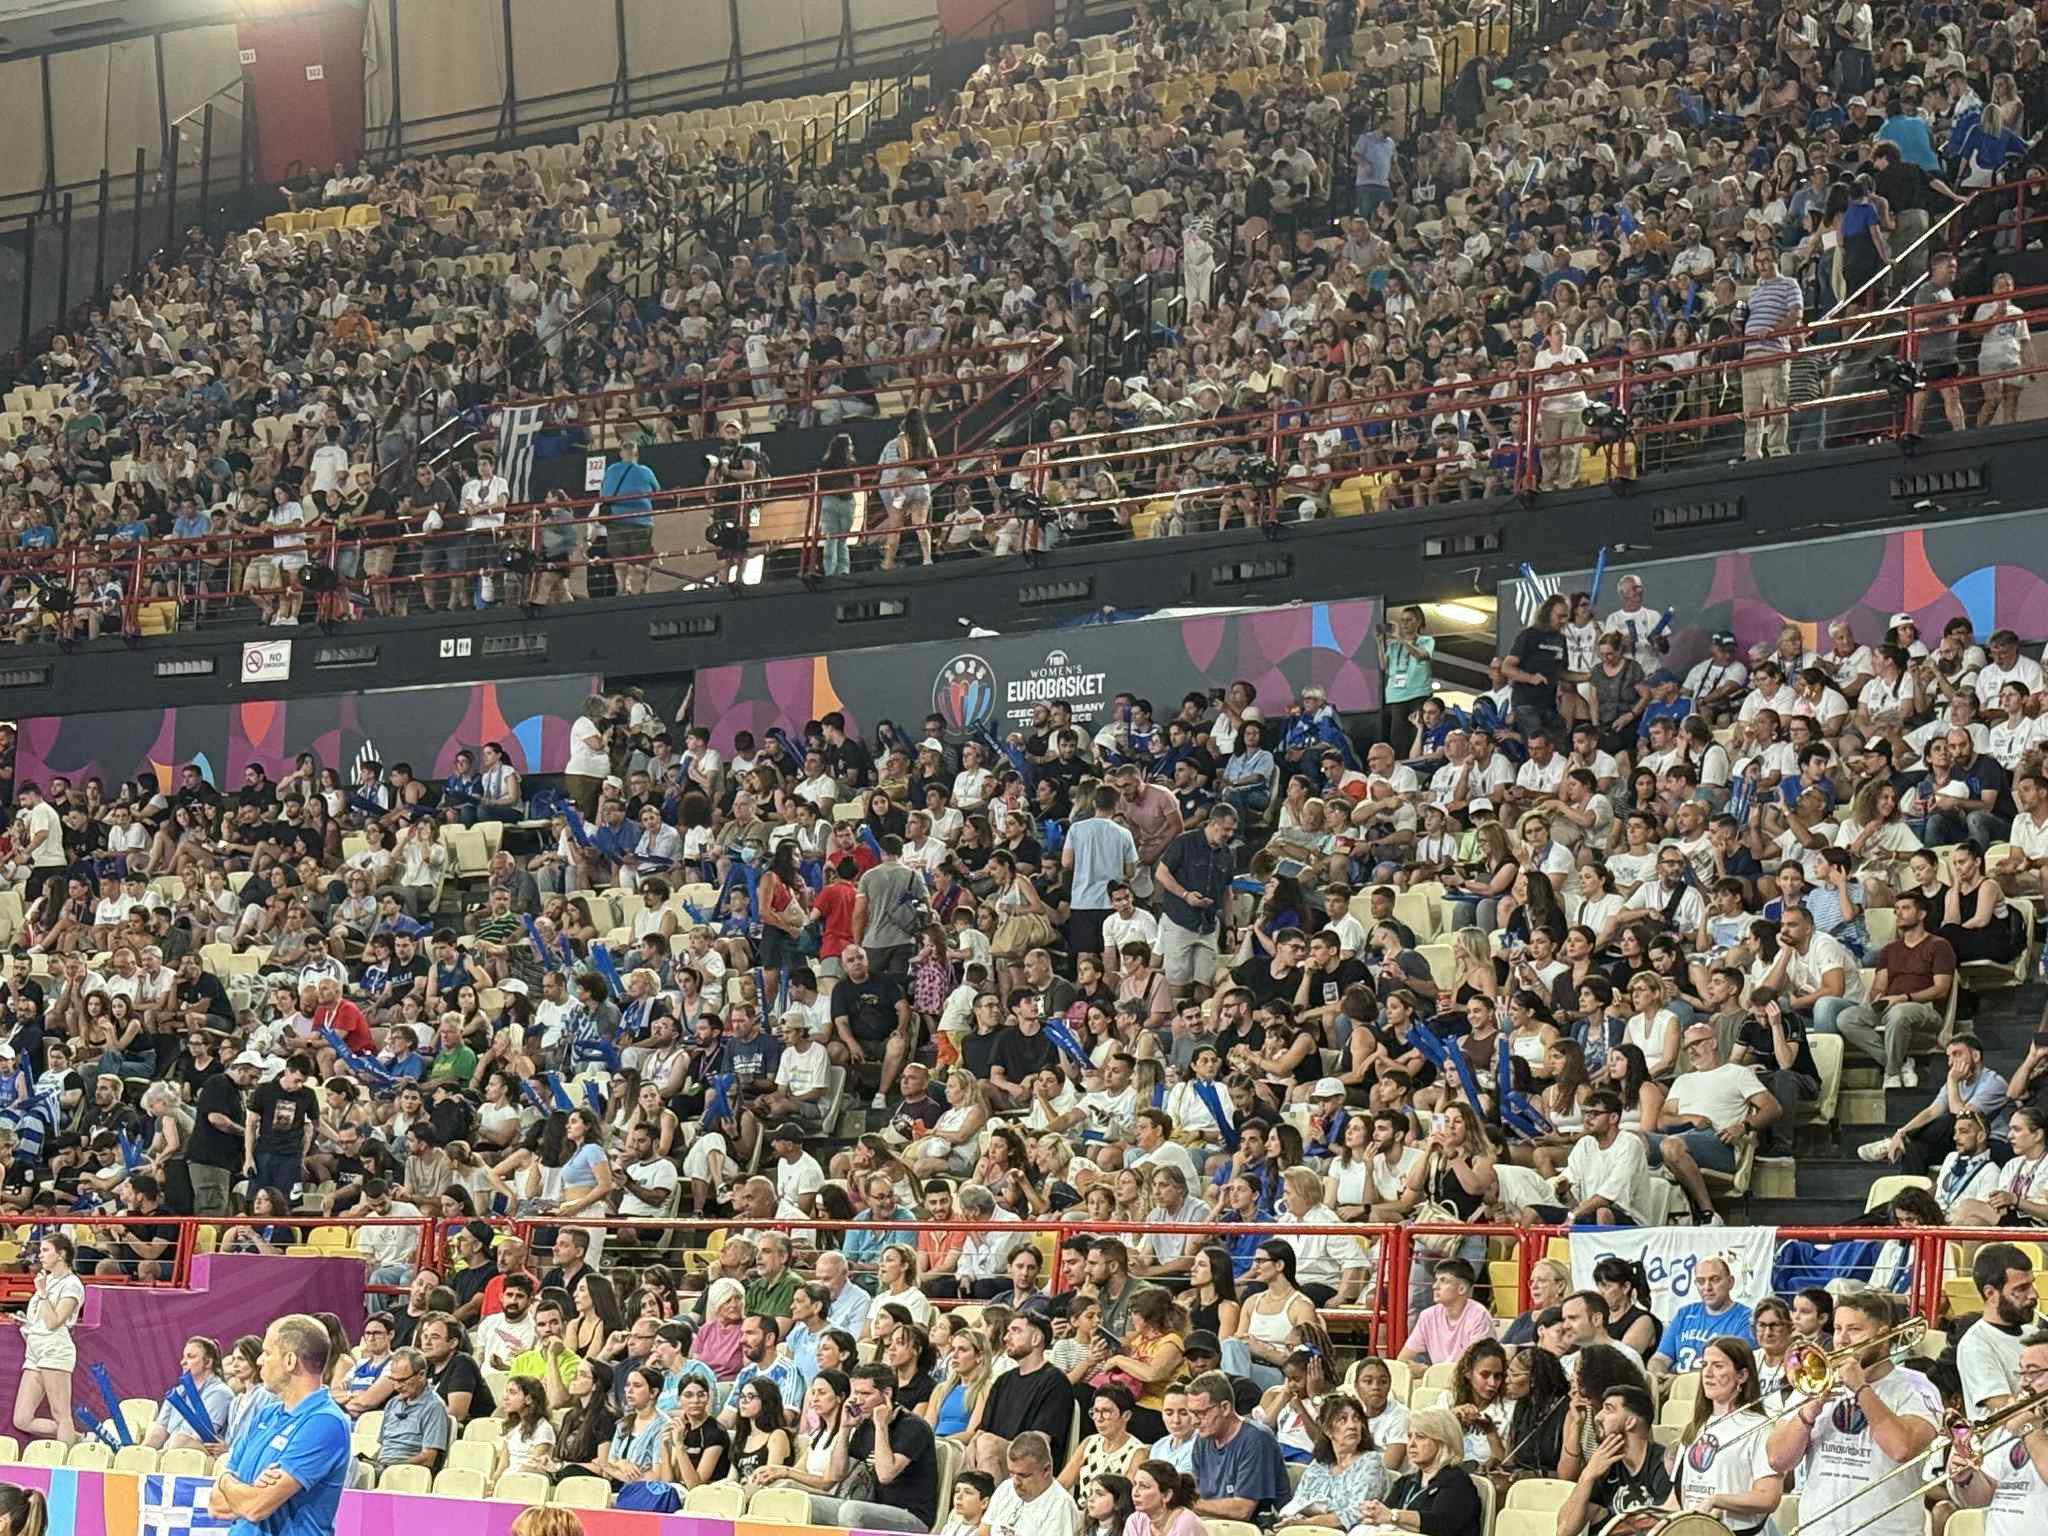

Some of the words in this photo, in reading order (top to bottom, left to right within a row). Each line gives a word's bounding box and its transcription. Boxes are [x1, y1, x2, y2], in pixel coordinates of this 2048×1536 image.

[269, 652, 282, 661] NO
[1030, 664, 1083, 678] WOMEN'S
[1007, 673, 1106, 702] EUROBASKET
[1007, 708, 1034, 719] CZEC
